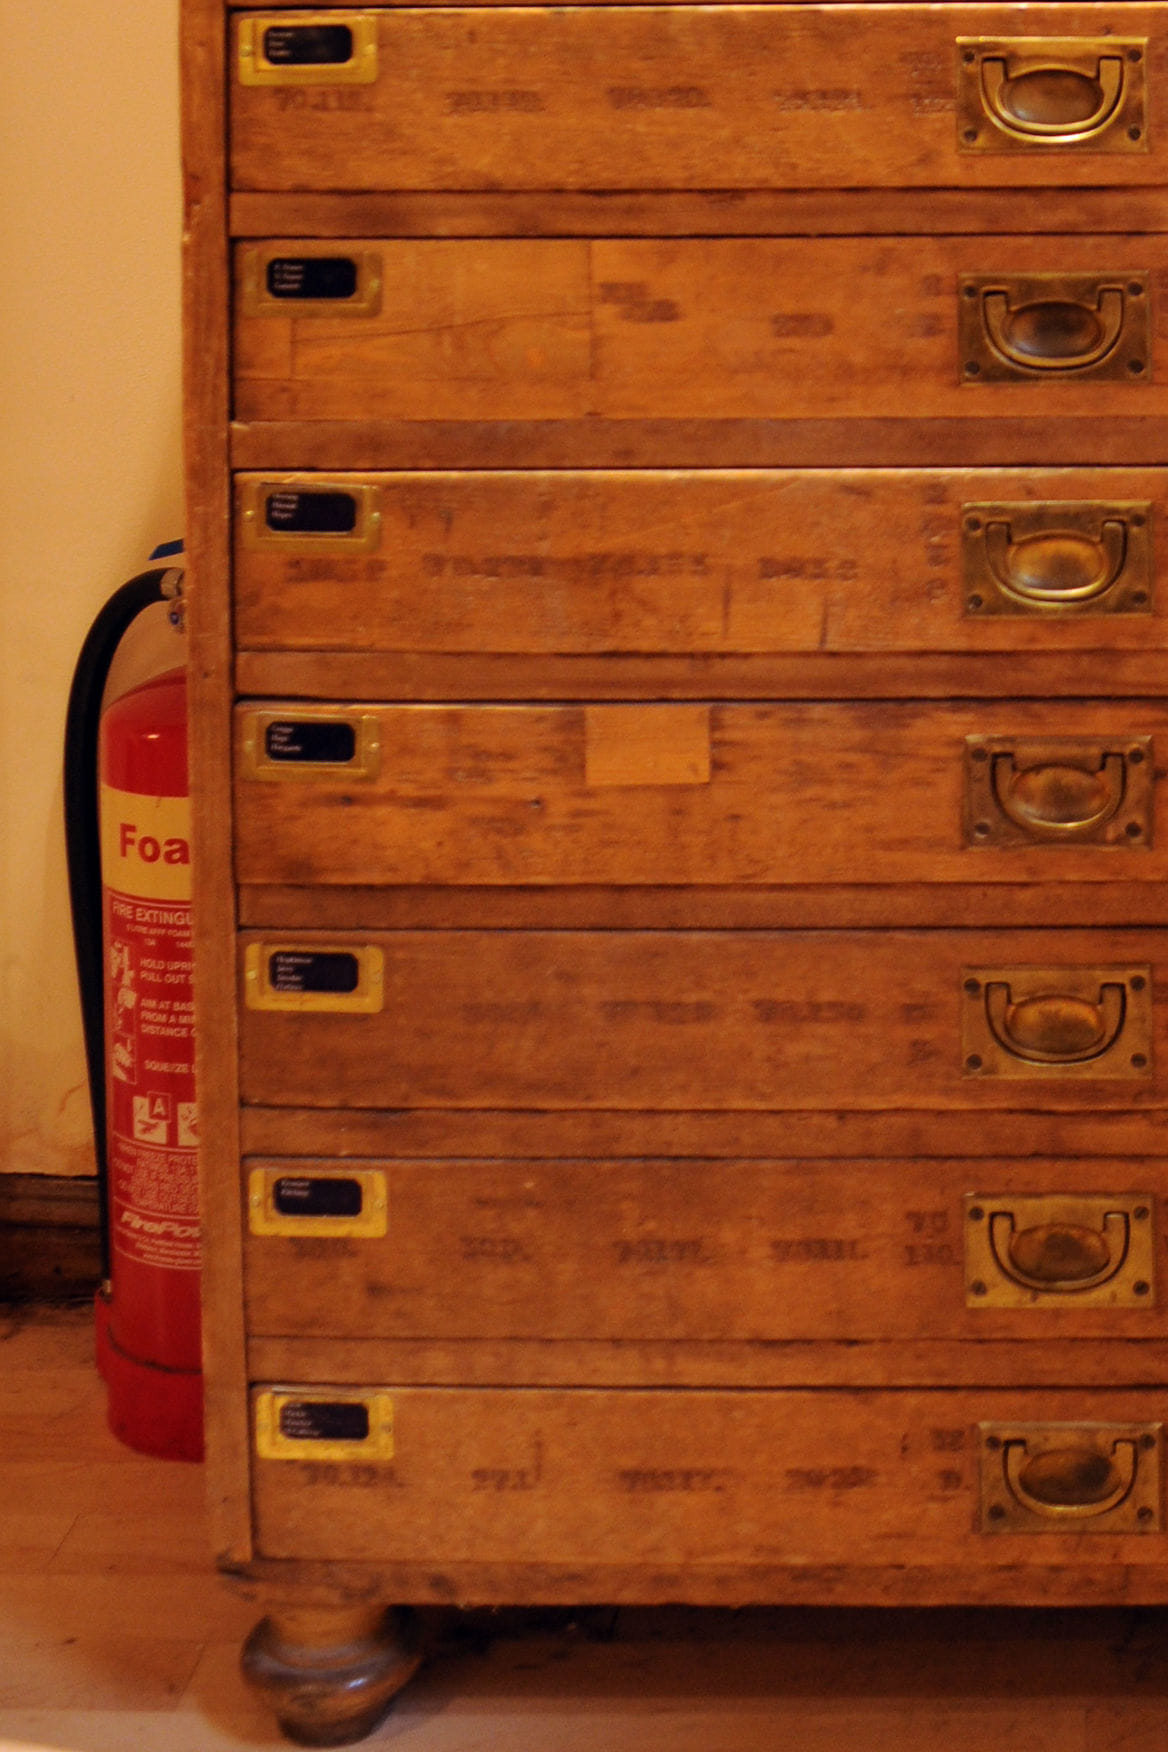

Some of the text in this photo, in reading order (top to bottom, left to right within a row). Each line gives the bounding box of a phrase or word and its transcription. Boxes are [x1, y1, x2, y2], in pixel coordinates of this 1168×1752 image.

[120, 823, 190, 864] Foa
[113, 901, 133, 919] FIRE
[140, 959, 164, 970] HOLD
[140, 971, 163, 983] PULL
[165, 974, 186, 984] OUT
[159, 1000, 171, 1009] AT
[141, 1011, 167, 1023] FROM
[168, 1015, 176, 1024] A
[141, 1024, 188, 1037] DISTANCE
[144, 1060, 188, 1073] SQUEEZE
[153, 1098, 166, 1115] A
